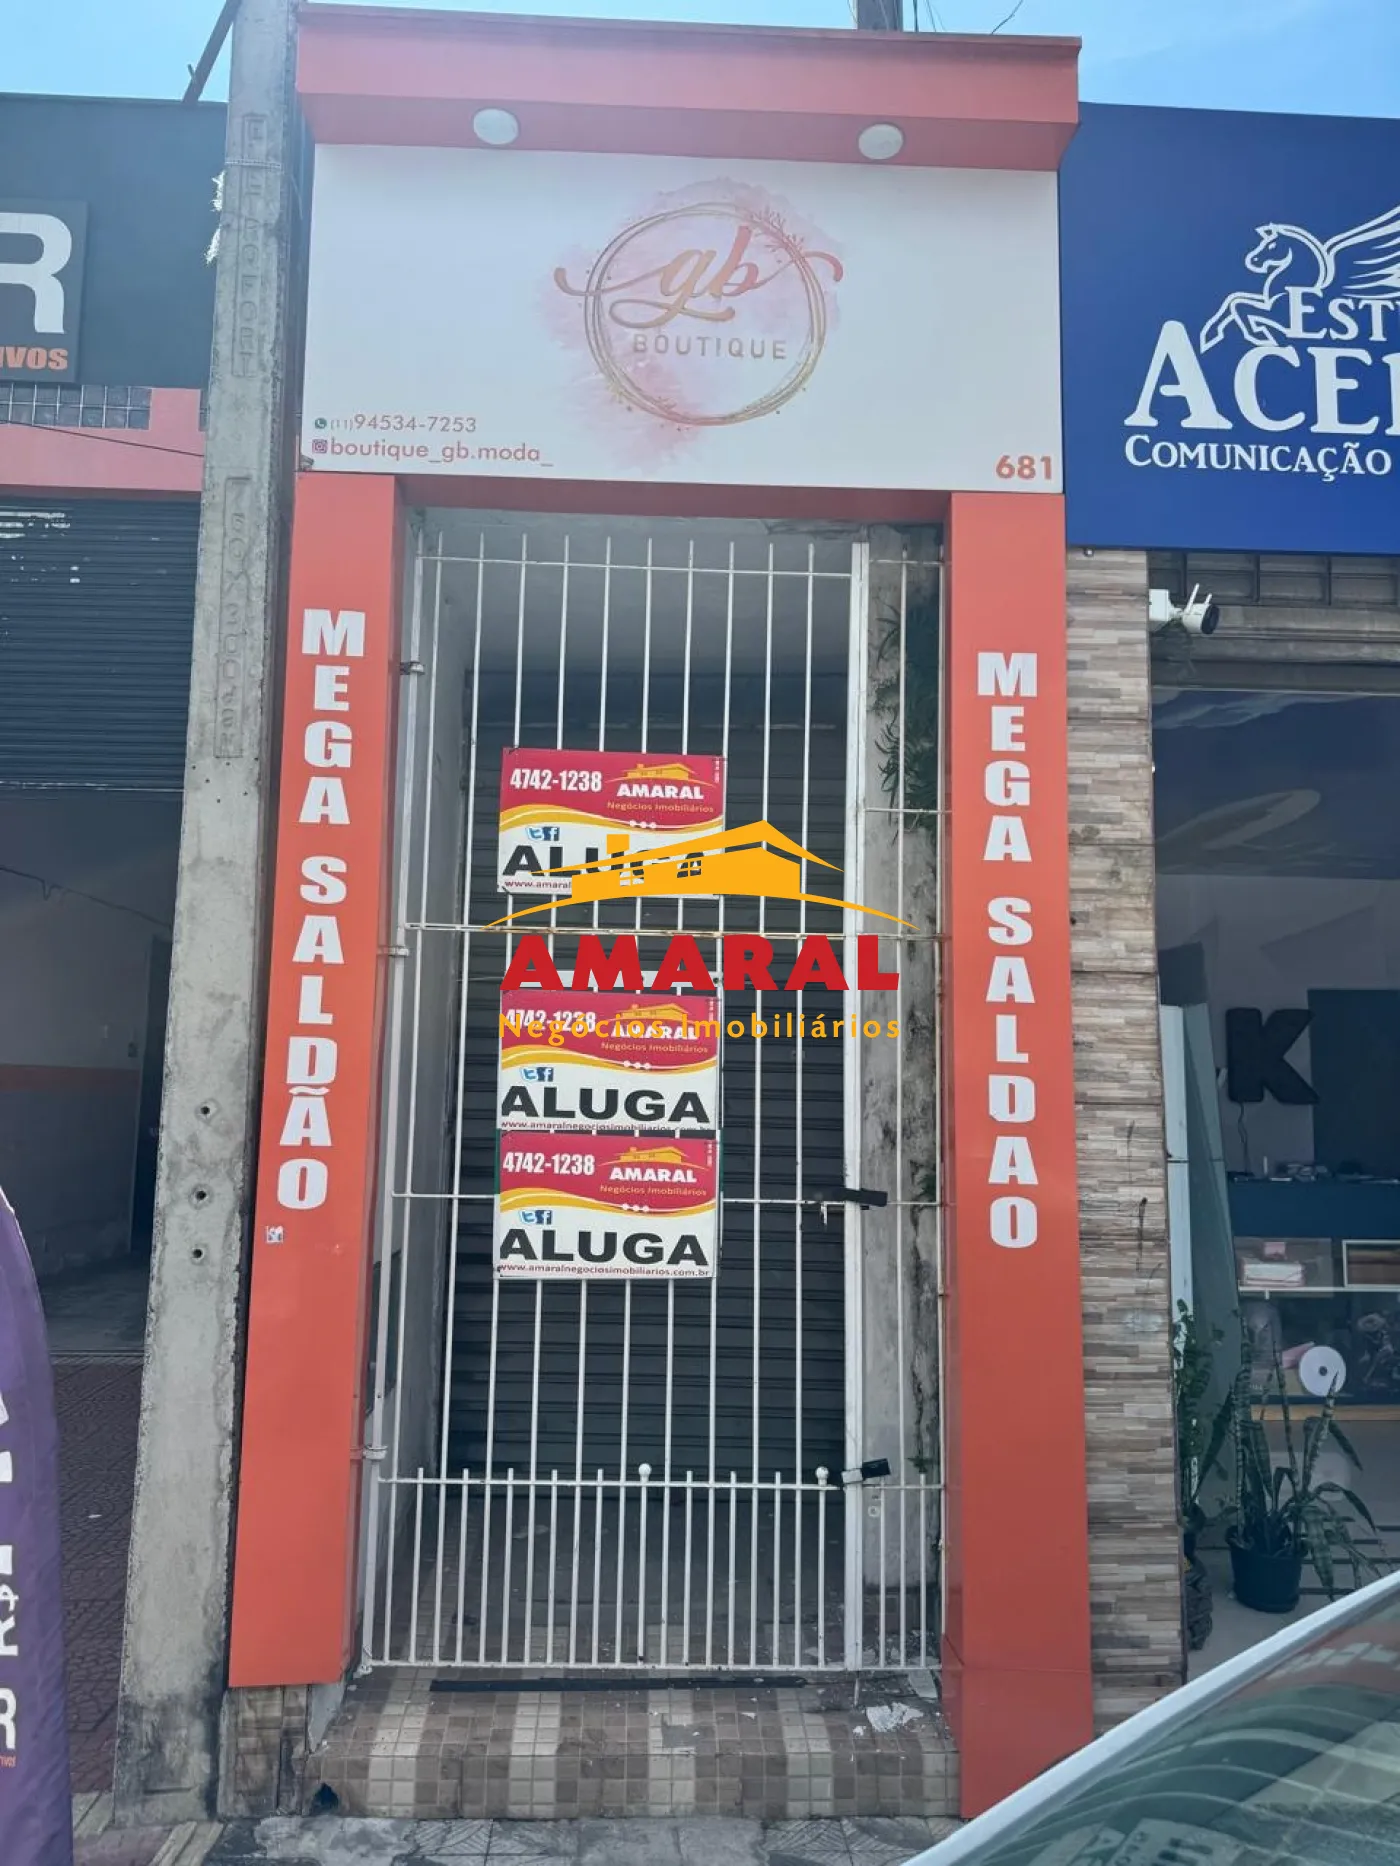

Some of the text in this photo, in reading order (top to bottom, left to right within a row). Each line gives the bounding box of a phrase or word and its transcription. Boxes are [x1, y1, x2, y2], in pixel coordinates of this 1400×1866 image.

[1285, 286, 1400, 341] EST
[632, 333, 787, 360] BOUTIQUE
[331, 437, 553, 467] boutique_gb.moda_
[996, 455, 1052, 480] 681
[510, 768, 602, 793] 4742-1238
[617, 783, 703, 800] AMARAL
[607, 802, 653, 813] Negócios
[277, 608, 366, 1210] MEGA SALDÃO
[977, 652, 1038, 1249] MEGA SALDAO
[601, 1042, 647, 1054] Negócios
[502, 1085, 709, 1124] ALUGA
[503, 1152, 595, 1175] 4742-1238
[610, 1167, 697, 1183] AMARAL
[601, 1185, 645, 1196] Negócios
[500, 1228, 709, 1266] ALUGA
